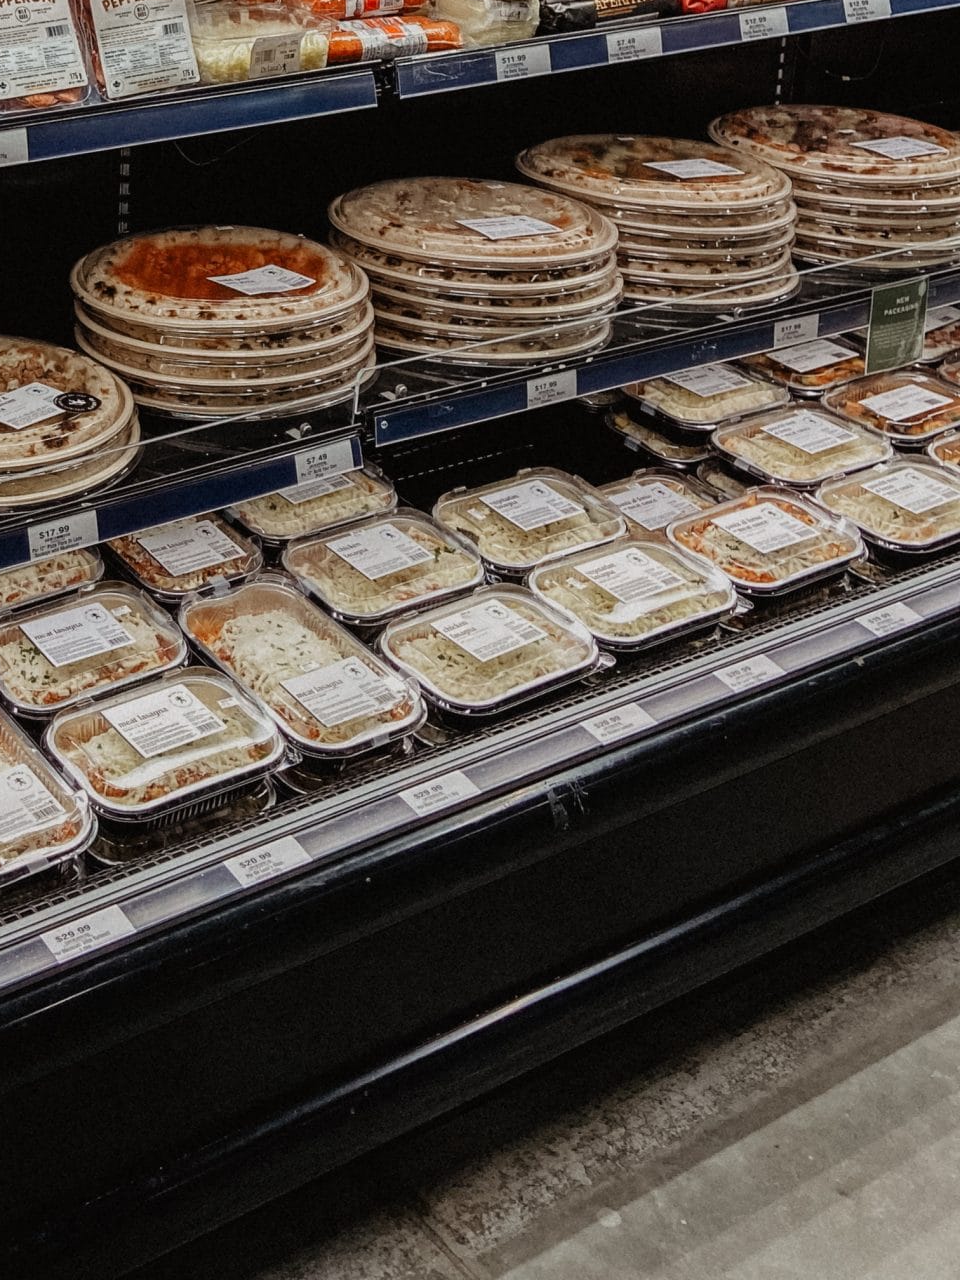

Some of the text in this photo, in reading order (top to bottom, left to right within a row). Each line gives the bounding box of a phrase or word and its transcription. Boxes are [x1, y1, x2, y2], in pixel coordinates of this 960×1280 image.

[502, 54, 526, 64] $11.99
[39, 524, 70, 540] $17.99
[34, 620, 84, 640] meat lasagna
[296, 678, 344, 698] meat lasagna
[118, 706, 168, 728] meat lasagna
[239, 852, 271, 869] $20.99
[54, 924, 92, 943] $29.99
